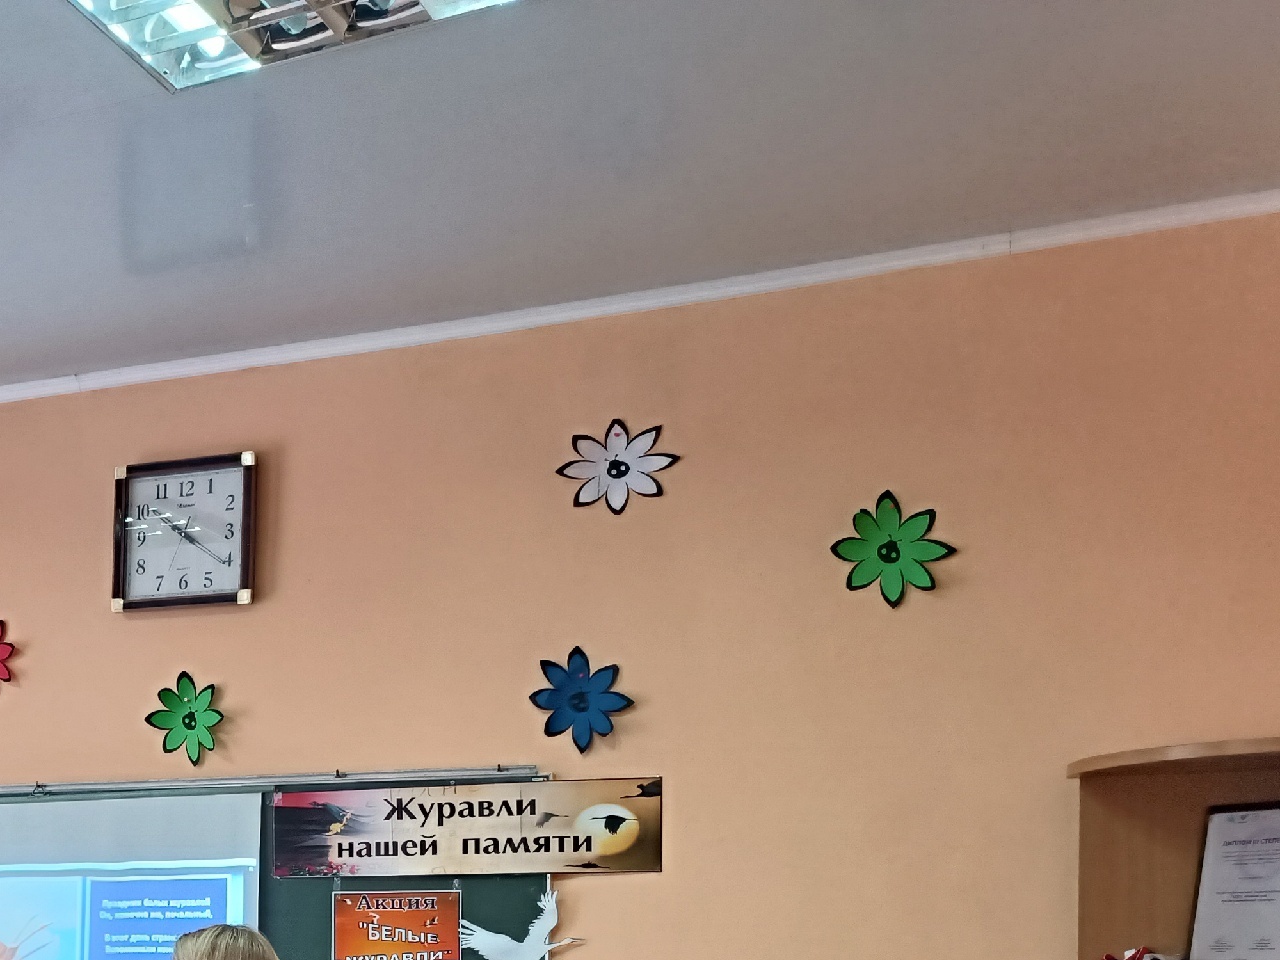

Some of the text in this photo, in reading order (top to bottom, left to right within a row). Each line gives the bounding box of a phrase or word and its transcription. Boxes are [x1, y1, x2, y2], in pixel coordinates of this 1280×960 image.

[154, 483, 168, 500] 11
[178, 480, 195, 498] 12
[206, 478, 214, 495] 1
[224, 494, 235, 511] 2
[135, 503, 150, 520] 10
[137, 530, 146, 548] 9
[224, 523, 235, 540] 3
[135, 558, 146, 575] 8
[224, 551, 234, 567] 4
[155, 575, 164, 592] 7
[178, 573, 188, 590] 6
[203, 571, 213, 589] 5
[383, 797, 537, 828] Журавли
[337, 834, 592, 858] нашей памяти
[355, 894, 438, 912] Акция
[359, 921, 440, 944] "БЕЛЫЕ
